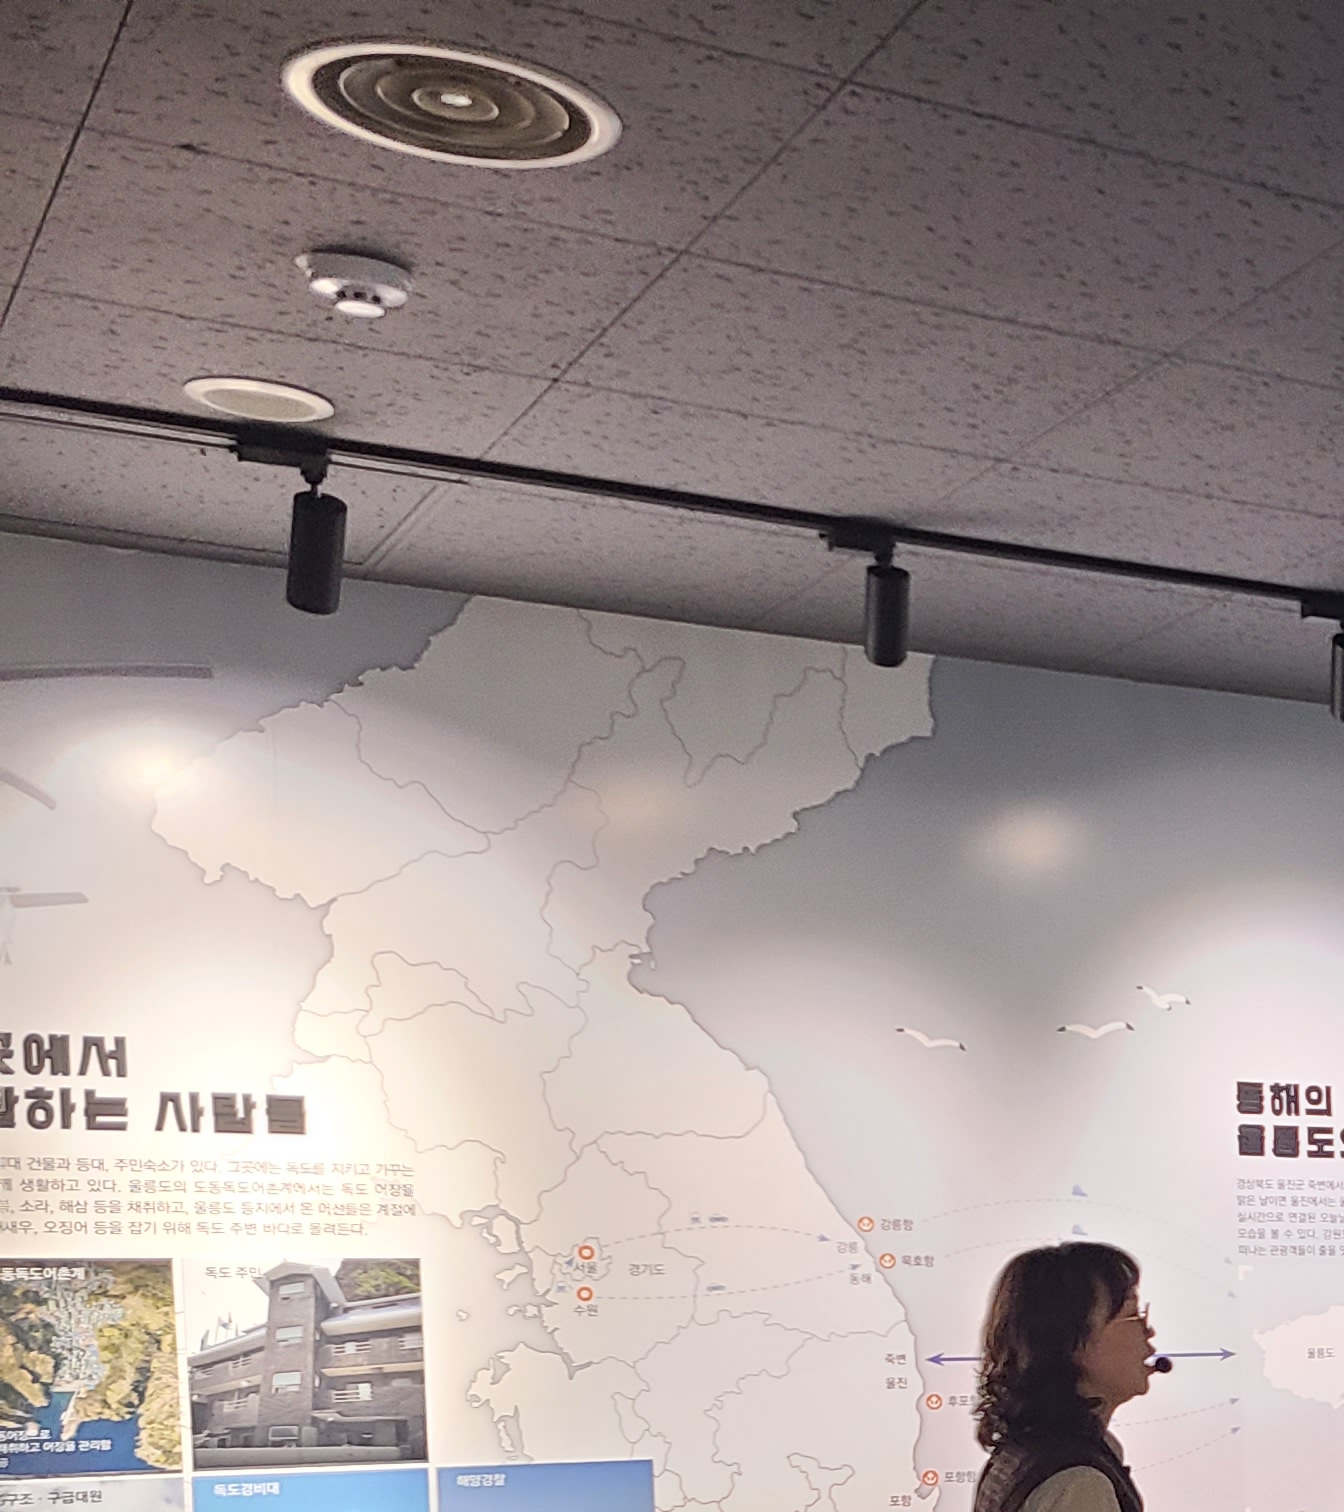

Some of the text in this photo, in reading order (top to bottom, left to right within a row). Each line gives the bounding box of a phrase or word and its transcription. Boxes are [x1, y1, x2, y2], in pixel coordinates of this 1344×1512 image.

[1236, 1081, 1332, 1117] 동해의
[154, 1091, 306, 1135] 사람들
[27, 1157, 415, 1177] 건물과 등대, 주민숙소가 있다. 그곳에는 독도를 지키고 가꾸는
[19, 1178, 81, 1192] 생활하고
[87, 1179, 121, 1192] 있다.
[128, 1179, 187, 1193] 울릉도의
[341, 1182, 370, 1195] 독도
[374, 1183, 414, 1197] 어장을
[1237, 1178, 1274, 1190] 경상북도
[1277, 1179, 1305, 1190] 울진군
[1308, 1179, 1344, 1191] 죽변에서
[1259, 1195, 1287, 1207] 날이면
[1290, 1196, 1337, 1207] 울진에서는
[19, 1200, 54, 1214] 소라,
[59, 1200, 88, 1214] 해삼
[93, 1200, 123, 1214] 등을
[127, 1201, 189, 1215] 채취하고,
[194, 1201, 236, 1215] 울릉도
[241, 1202, 295, 1215] 등지에서
[300, 1202, 314, 1216] 온
[318, 1202, 373, 1216] 어선들은
[376, 1203, 416, 1217] 계절에
[1237, 1212, 1285, 1223] 실시간으로
[1288, 1212, 1317, 1223] 연결된
[43, 1221, 369, 1236] 오징어 등을 잡기 위해 독도 주변 바다로 몰려든다.
[881, 1219, 914, 1231] 강릉항
[1237, 1228, 1266, 1239] 모습을
[1283, 1229, 1294, 1239] 수
[1296, 1229, 1319, 1240] 있다.
[1238, 1245, 1266, 1256] 떠나는
[1269, 1245, 1316, 1256] 관광객들이
[1318, 1245, 1336, 1256] 줄을
[573, 1261, 597, 1274] 서울
[902, 1255, 935, 1268] 묵호항
[205, 1266, 264, 1279] 독도 주민
[628, 1263, 666, 1277] 경기도
[573, 1304, 599, 1317] 수원
[1307, 1347, 1336, 1359] 울릉도
[456, 1473, 506, 1488] 해양경찰
[213, 1482, 280, 1497] 독도경비대
[47, 1490, 103, 1504] 구급대원
[889, 1494, 912, 1507] 포항
